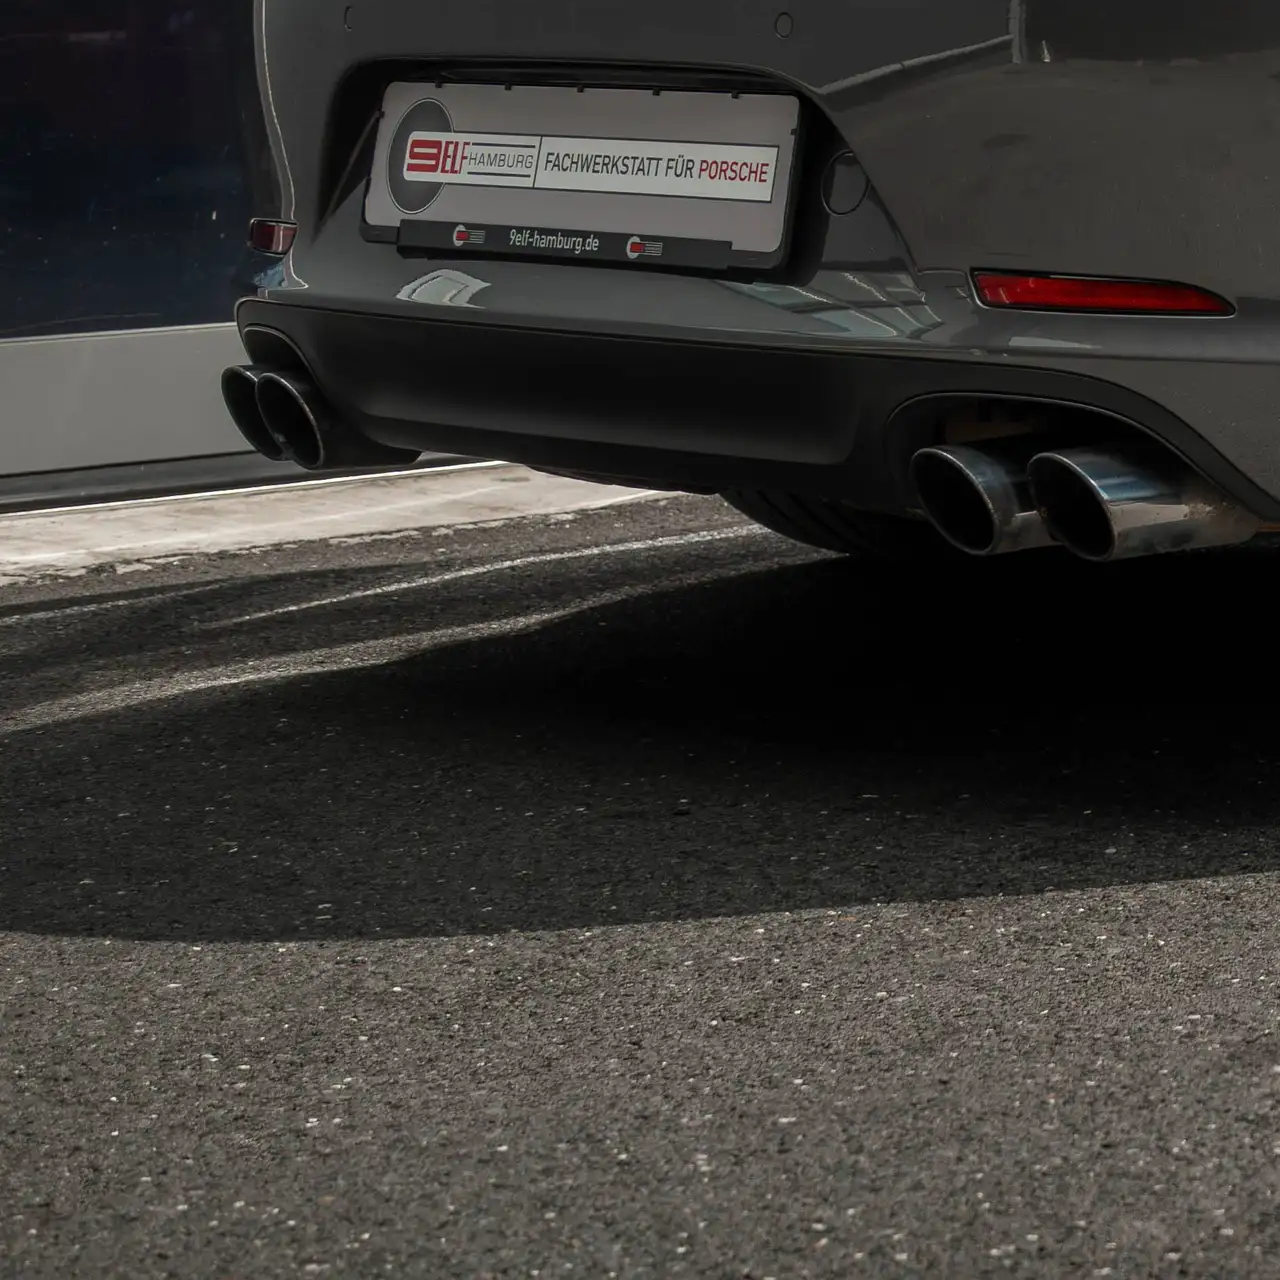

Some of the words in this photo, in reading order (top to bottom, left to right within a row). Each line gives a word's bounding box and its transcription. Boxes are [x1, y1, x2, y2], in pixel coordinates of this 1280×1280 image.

[467, 151, 535, 169] HAMBURG
[544, 152, 664, 177] FACHWERKSTATT
[665, 155, 695, 179] FÜR
[698, 160, 770, 183] PORSCHE
[509, 229, 600, 254] 9elf-hamburg.de
